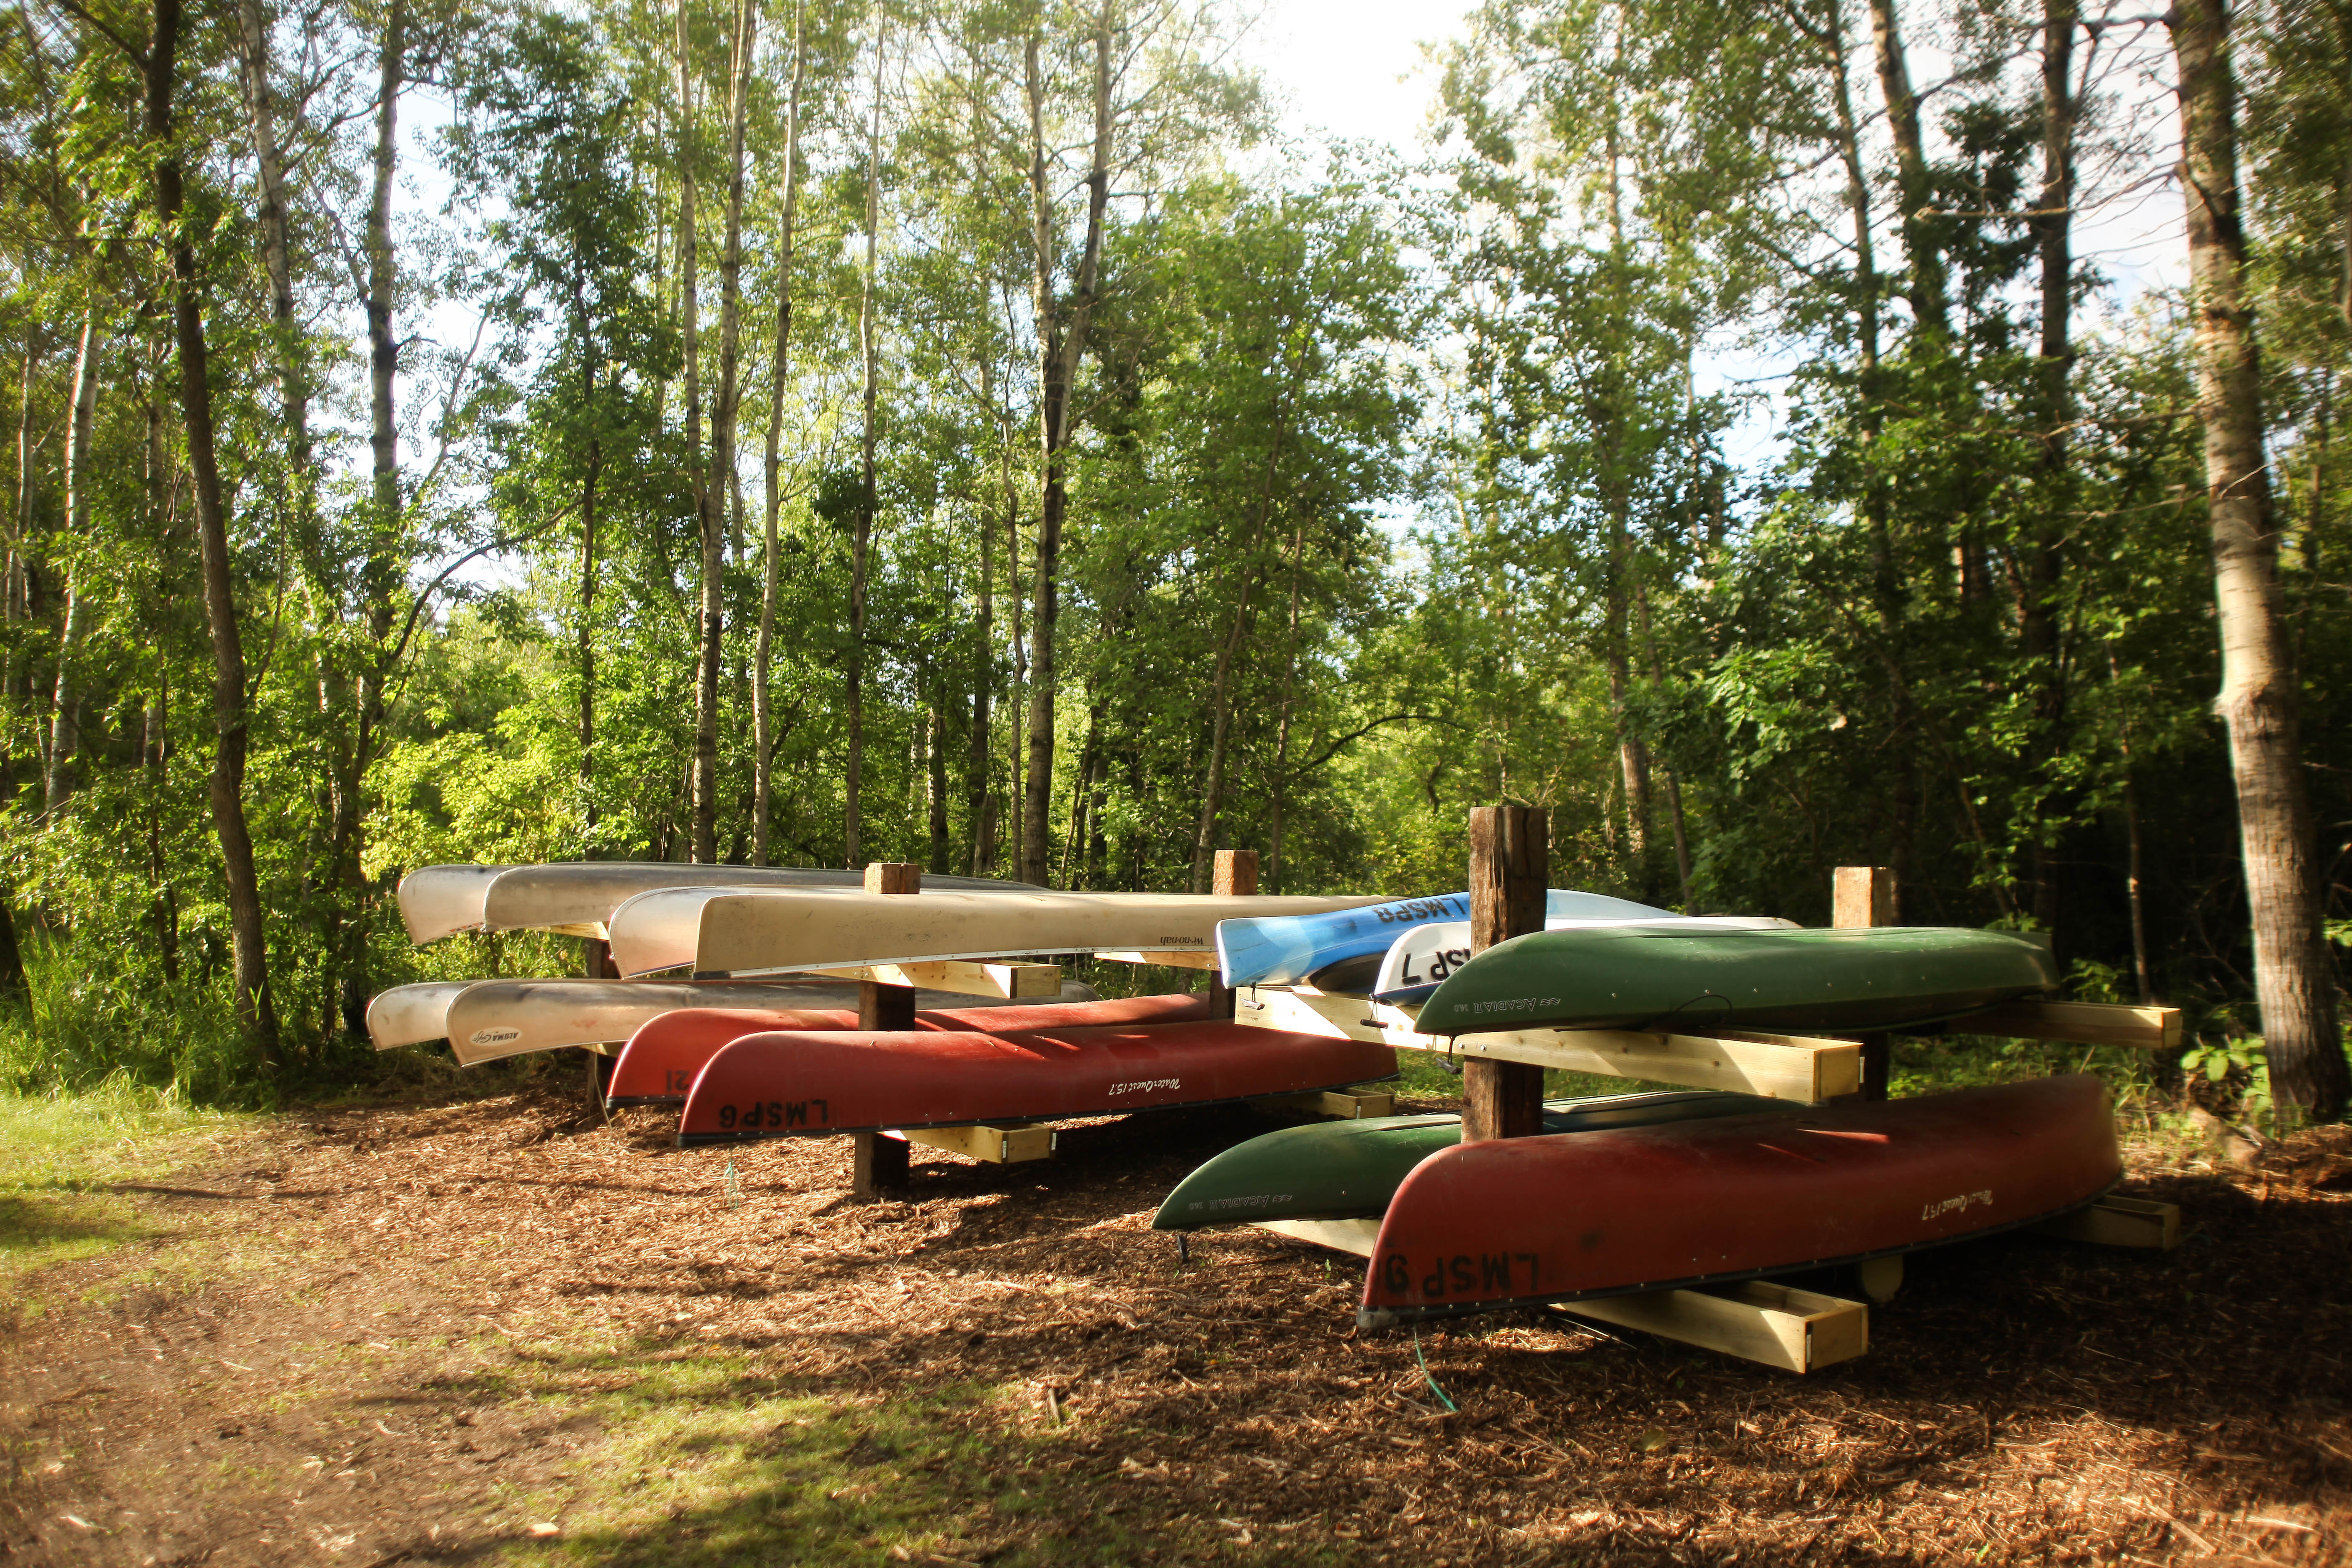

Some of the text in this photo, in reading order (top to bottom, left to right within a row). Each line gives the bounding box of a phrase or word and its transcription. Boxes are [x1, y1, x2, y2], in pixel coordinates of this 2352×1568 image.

[1402, 953, 1421, 985] 7
[1483, 998, 1536, 1012] ACADIA
[666, 1070, 689, 1092] 21
[1219, 1195, 1269, 1208] ACADIA
